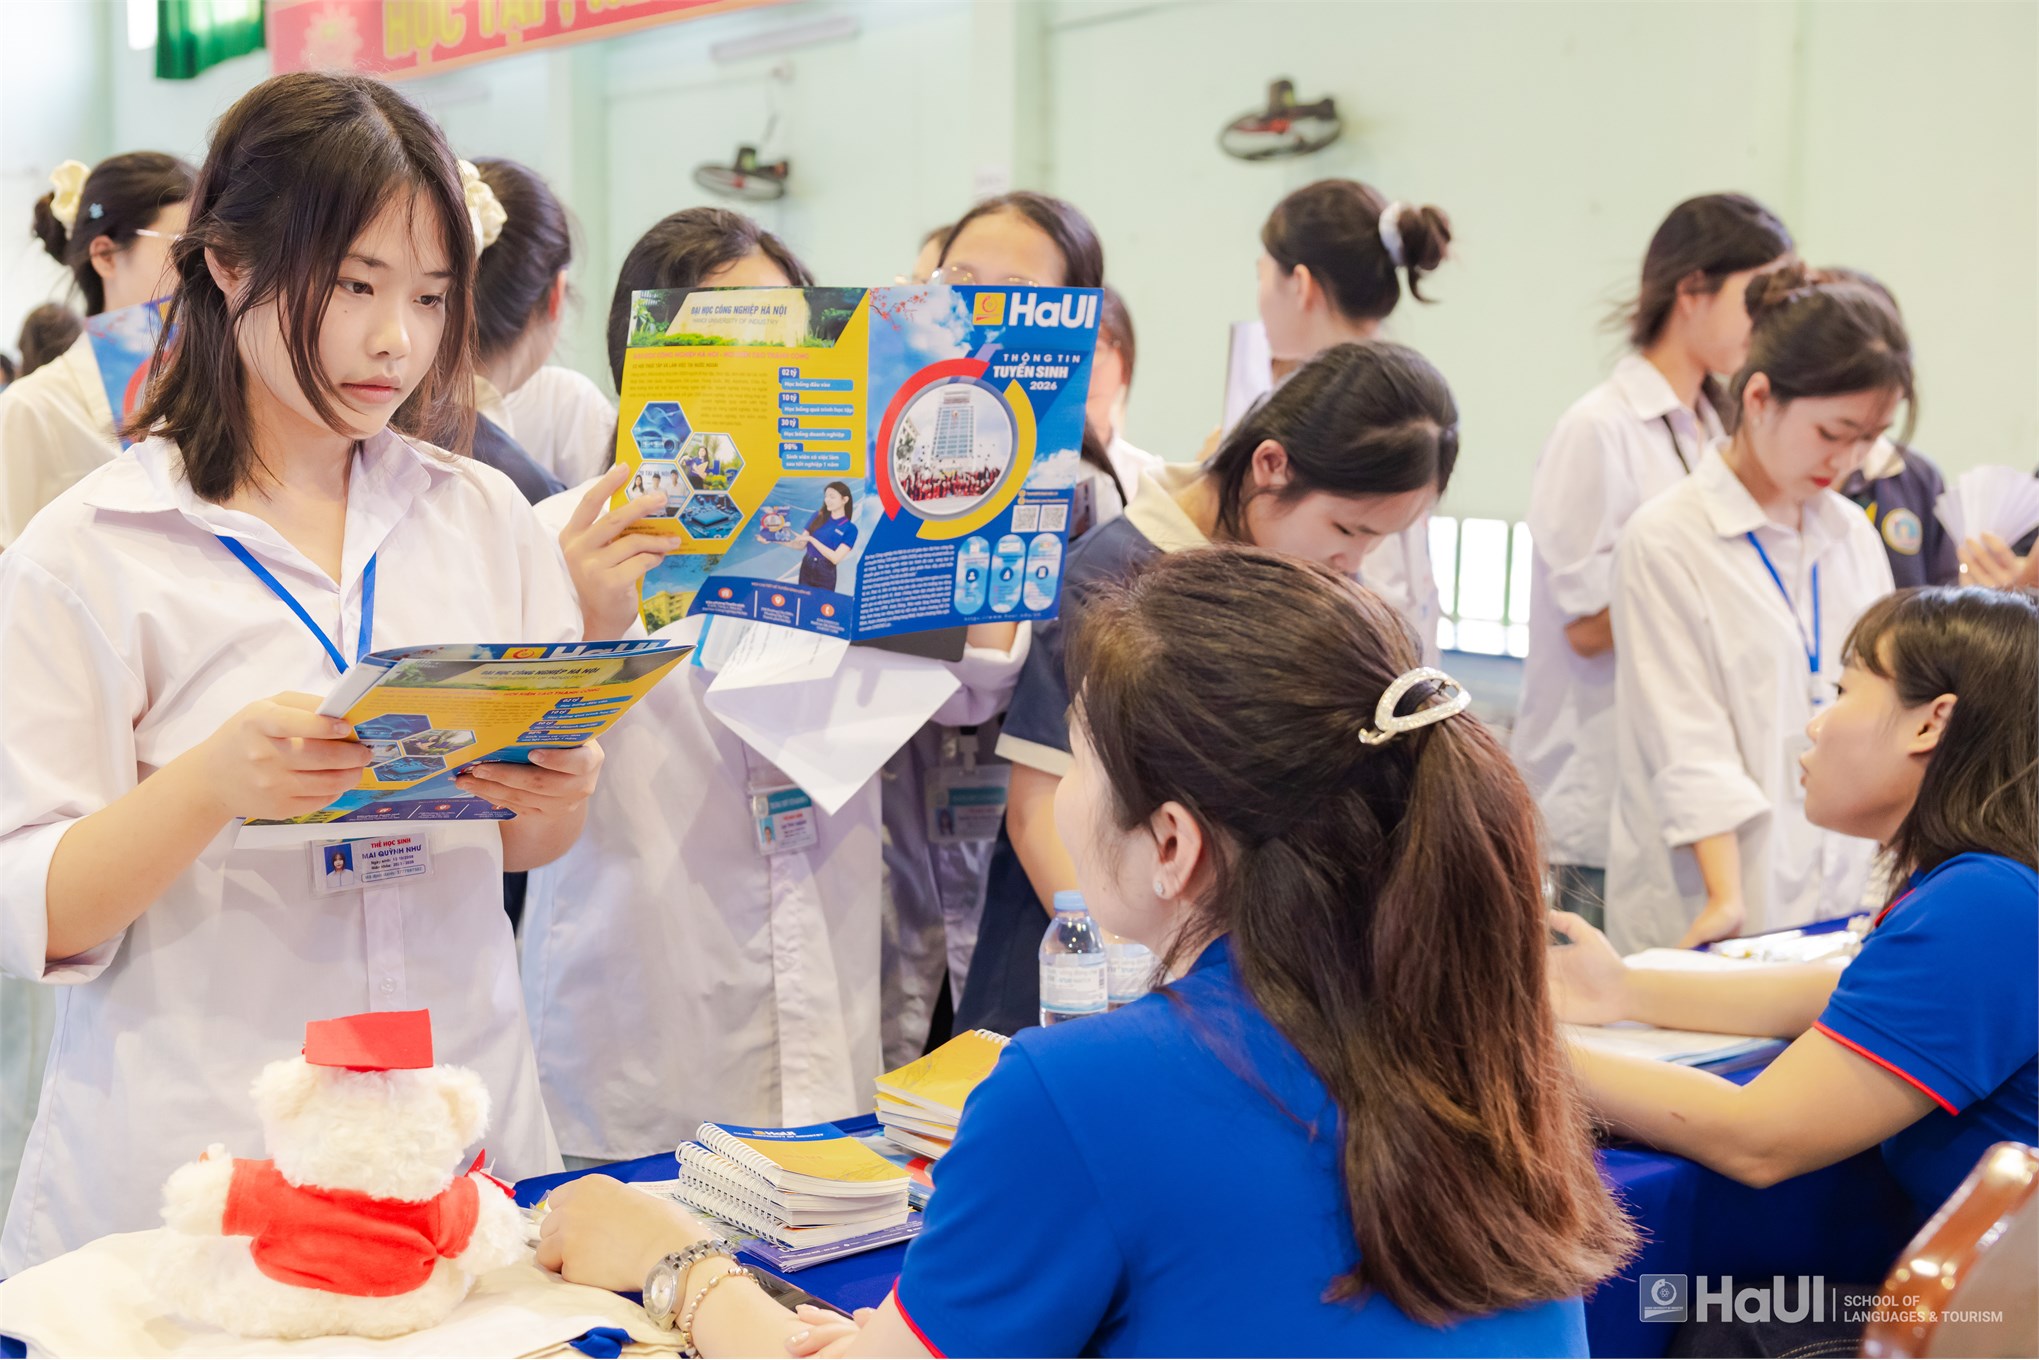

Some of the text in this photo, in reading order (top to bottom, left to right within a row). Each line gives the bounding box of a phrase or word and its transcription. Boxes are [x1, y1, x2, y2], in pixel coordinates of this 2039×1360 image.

[1008, 292, 1098, 328] HaUI
[1003, 352, 1052, 362] THÔNG
[1036, 366, 1069, 378] SINH
[1030, 381, 1058, 390] 2026
[378, 848, 404, 857] QUỲNH
[406, 844, 422, 852] NHƯ
